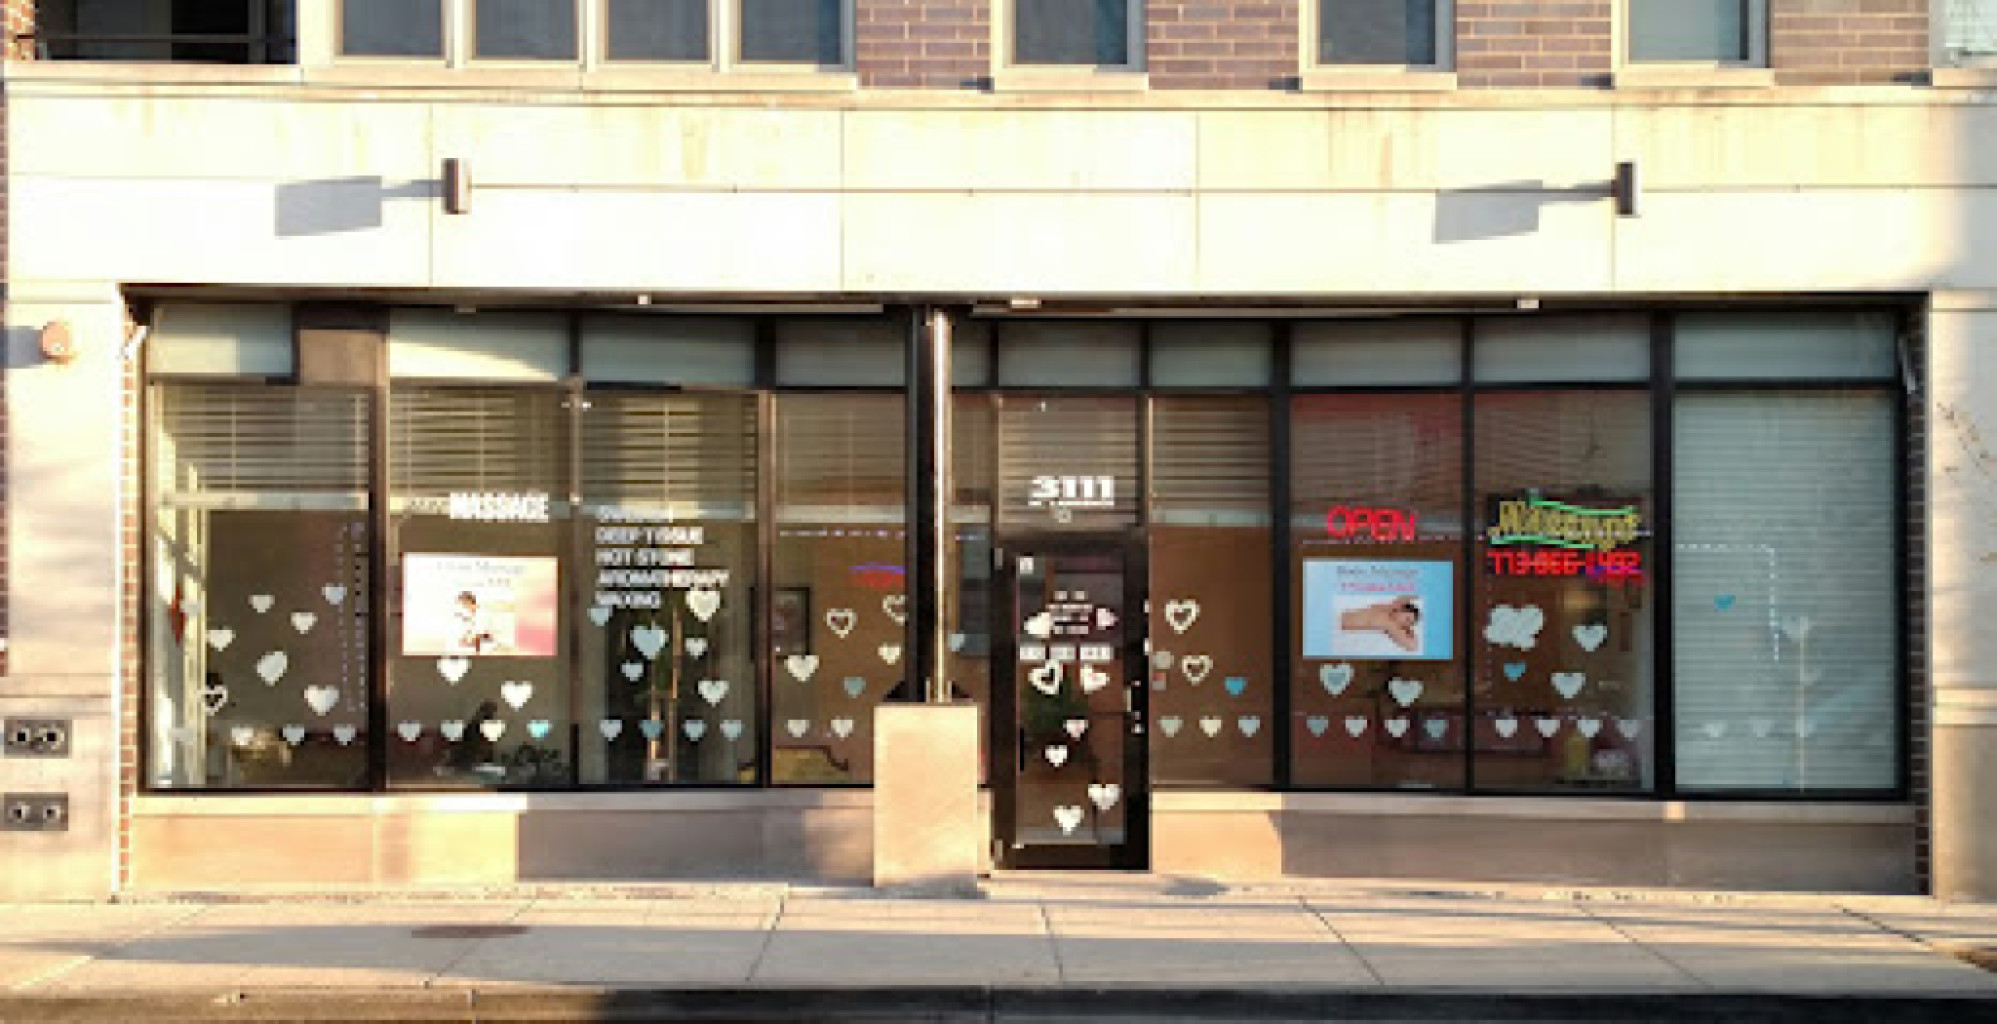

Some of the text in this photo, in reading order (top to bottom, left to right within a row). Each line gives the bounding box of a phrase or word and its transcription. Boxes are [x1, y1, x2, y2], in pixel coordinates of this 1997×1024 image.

[1029, 475, 1115, 499] 3111
[449, 492, 549, 523] MASSAGE
[1327, 505, 1417, 541] OPEN
[595, 526, 704, 545] DEEP TISSUE
[595, 548, 695, 566] HOT STONE
[595, 569, 730, 588] AROMATHERAPY
[595, 590, 662, 609] WAXING
